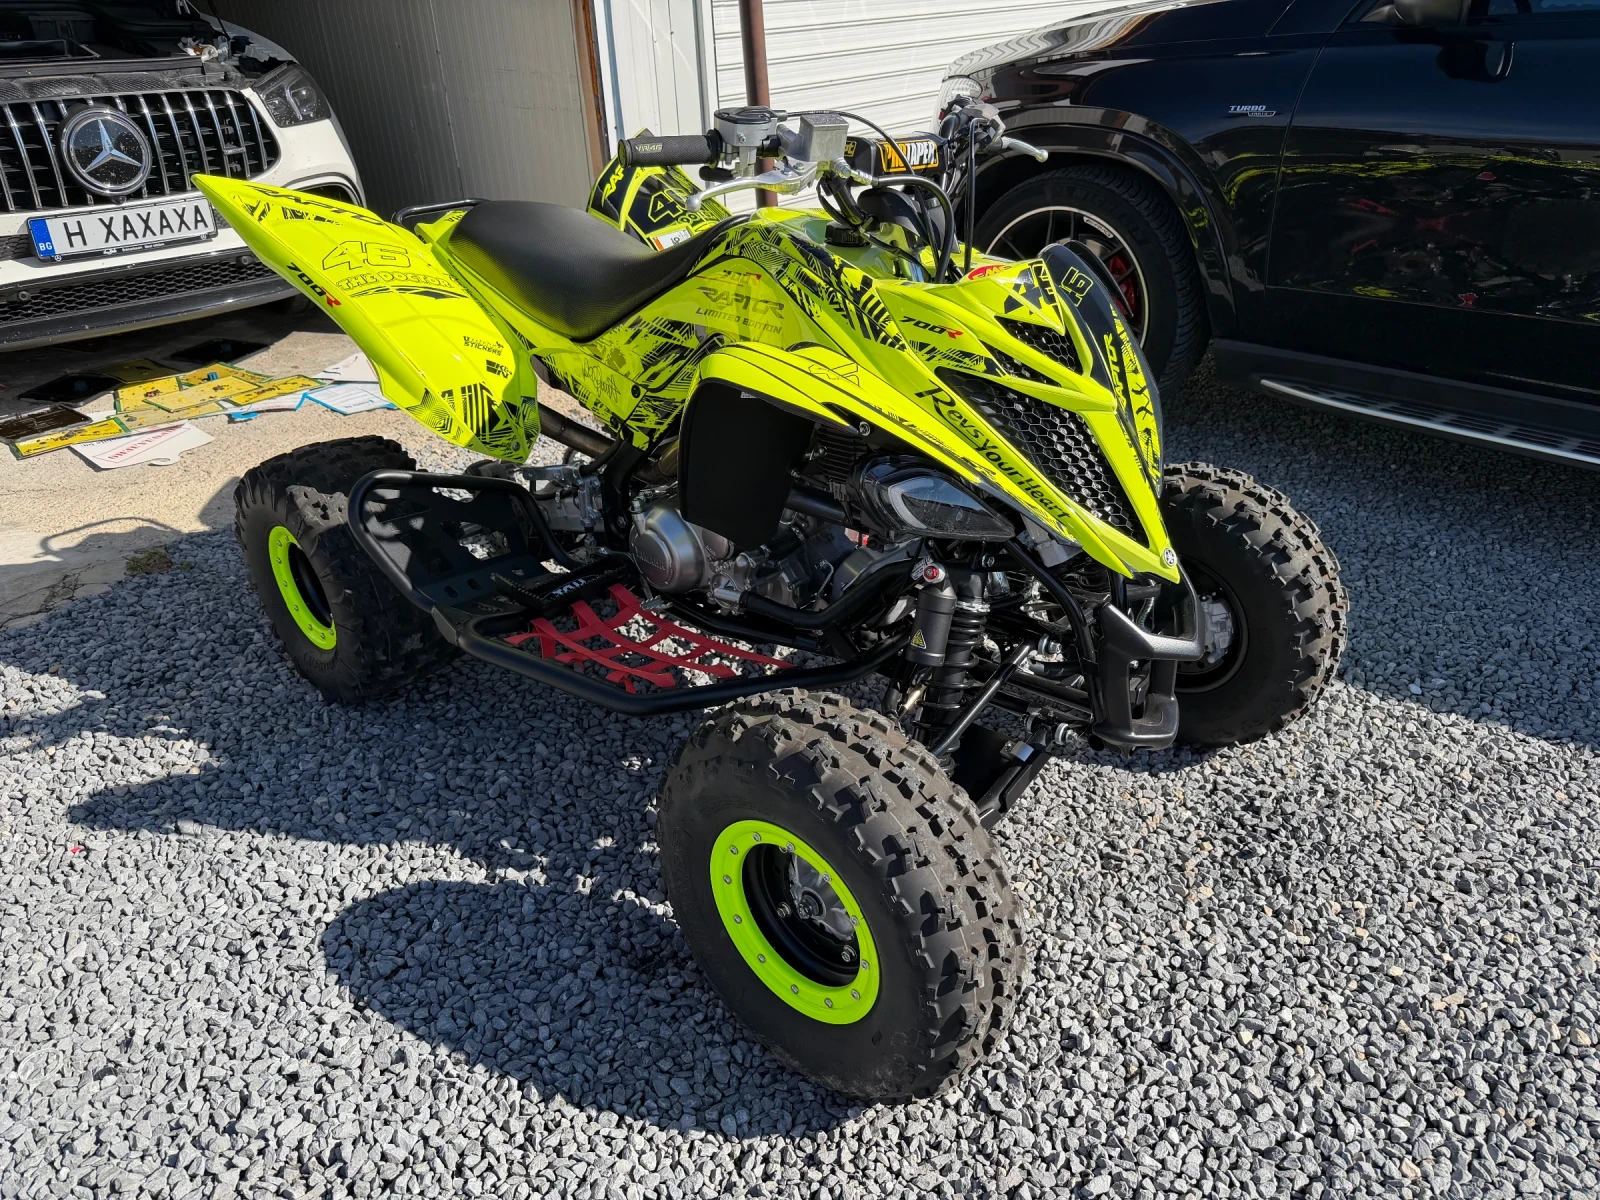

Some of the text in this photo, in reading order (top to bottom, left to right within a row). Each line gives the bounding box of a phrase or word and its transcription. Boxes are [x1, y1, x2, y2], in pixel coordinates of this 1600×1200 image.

[63, 204, 209, 248] H XAXAXA
[38, 241, 53, 251] BG
[322, 240, 411, 271] 46
[286, 261, 342, 309] 700R
[335, 270, 456, 292] THE DOCTOR
[695, 286, 785, 320] RAPTOR
[695, 307, 782, 335] LIMITED EDITION
[900, 315, 964, 340] 700R
[463, 341, 502, 357] STICKERS
[914, 378, 985, 451] Revs
[977, 438, 1025, 486] Your
[1023, 477, 1072, 519] Heart
